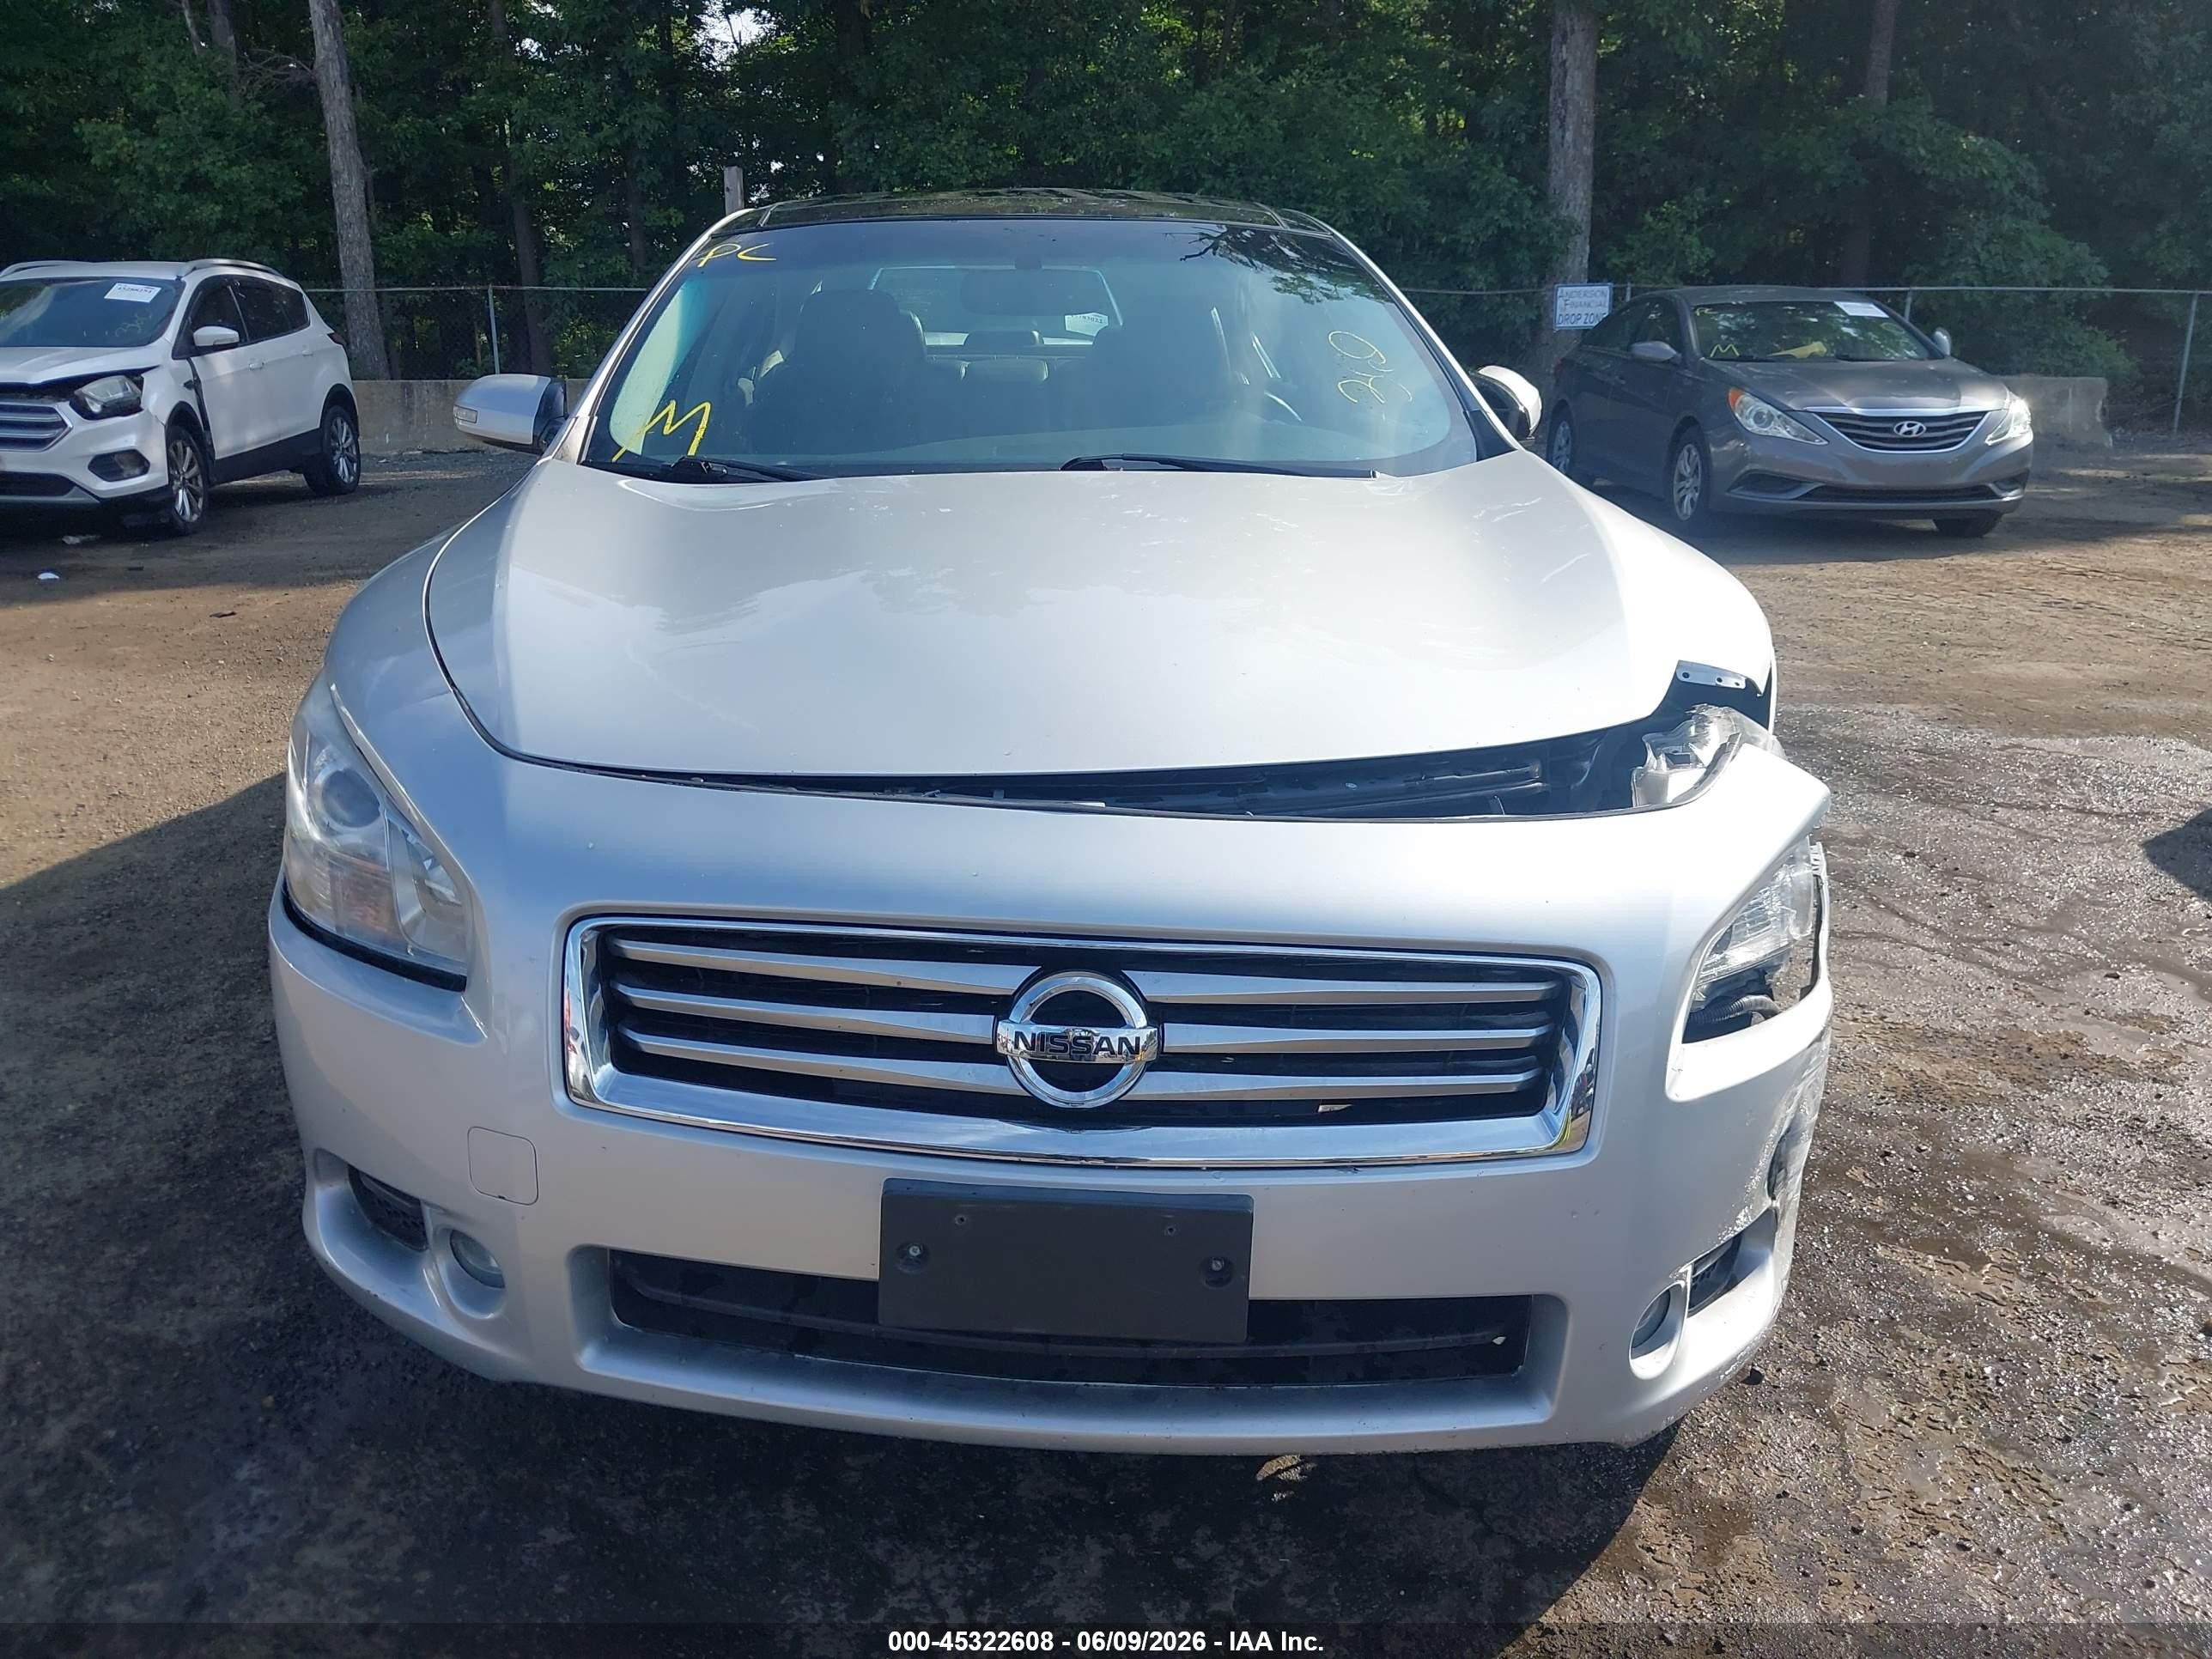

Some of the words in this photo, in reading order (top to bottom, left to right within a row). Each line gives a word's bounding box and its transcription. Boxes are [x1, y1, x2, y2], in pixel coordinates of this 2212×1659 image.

[1558, 313, 1582, 325] DROP
[611, 398, 711, 463] M
[1014, 1030, 1140, 1055] NISSAN
